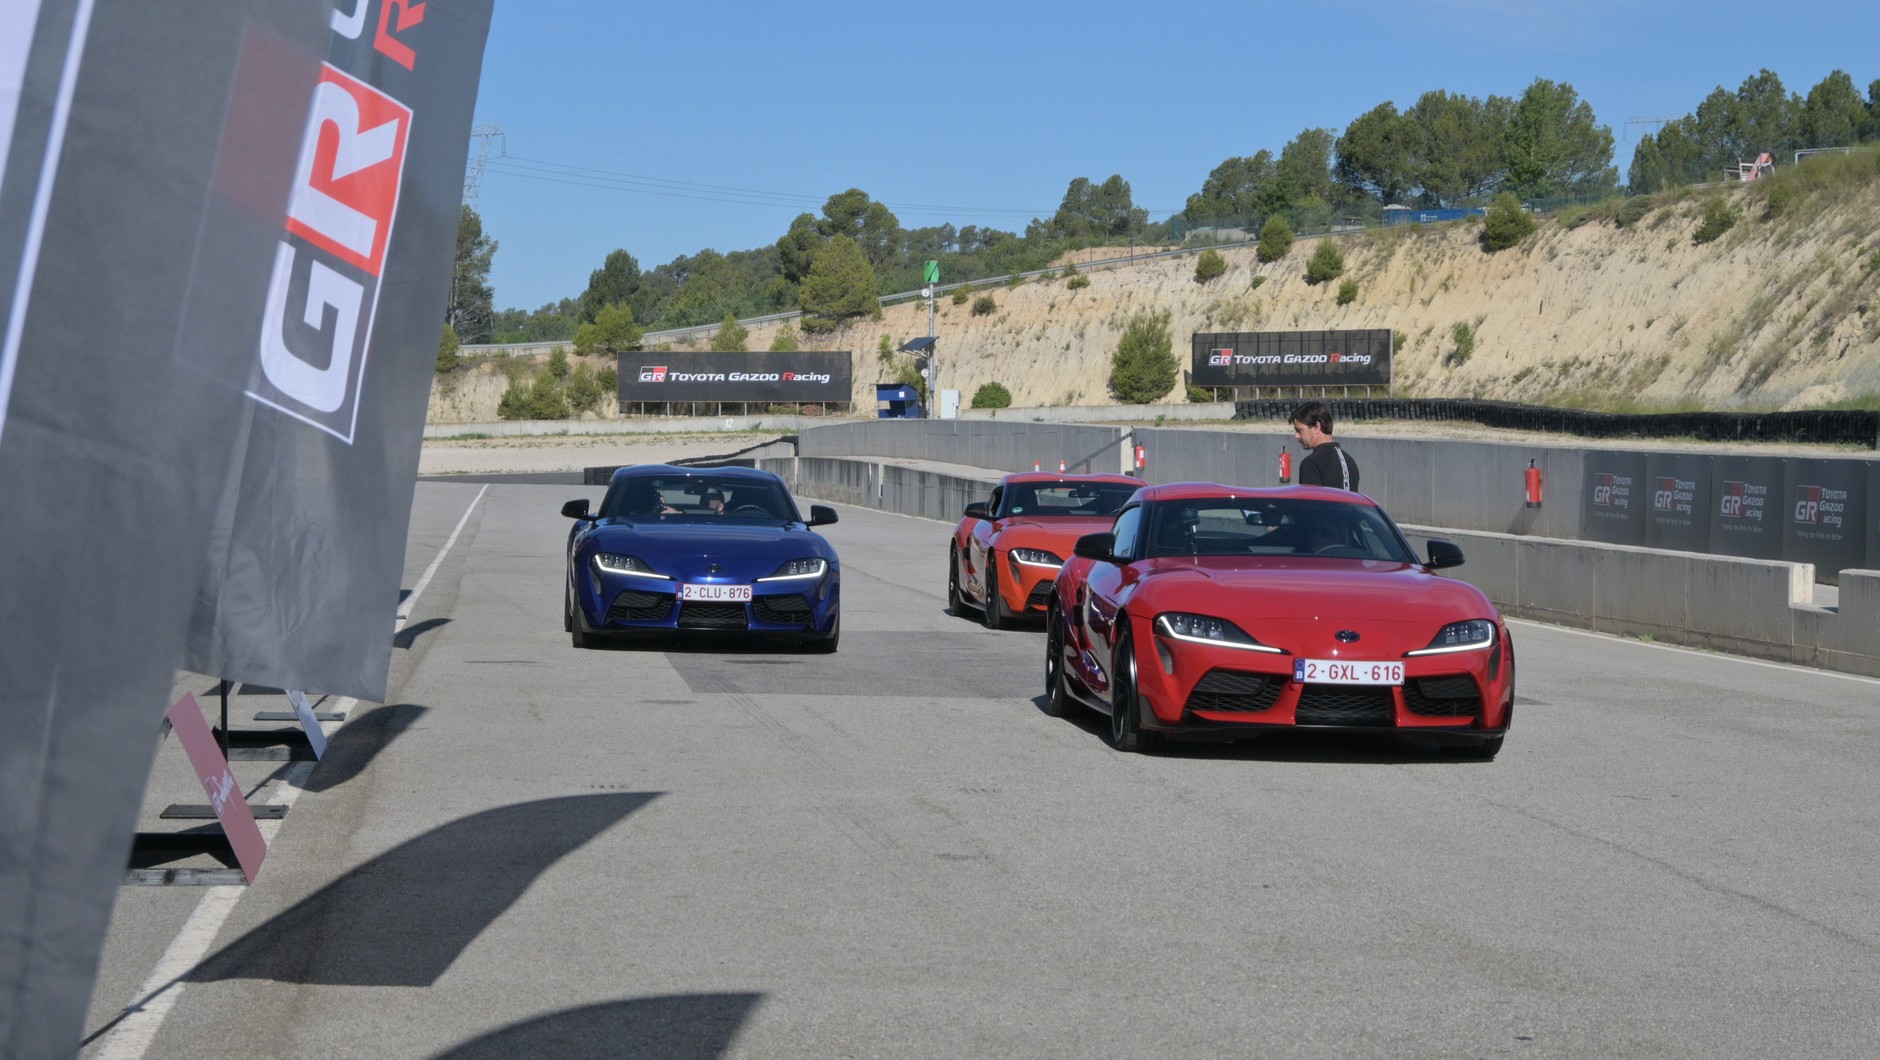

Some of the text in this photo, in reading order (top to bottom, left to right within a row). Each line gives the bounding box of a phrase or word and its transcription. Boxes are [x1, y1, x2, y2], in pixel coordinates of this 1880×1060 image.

[260, 80, 400, 413] GR
[1234, 355, 1281, 364] TOYOTA
[1283, 354, 1327, 363] GAZOO
[1329, 353, 1371, 365] Racing
[669, 372, 725, 381] TOYOTA
[728, 372, 779, 381] GAZOO
[782, 372, 830, 384] Racing
[725, 418, 734, 428] 12
[1613, 475, 1632, 486] TOYOTA
[1675, 479, 1696, 490] TOYOTA
[1611, 486, 1629, 496] GAZOO
[1744, 483, 1767, 495] TOYOTA
[1821, 488, 1847, 500] TOYOTA
[1673, 490, 1693, 501] GAZOO
[1742, 495, 1764, 507] GAZOO
[1819, 500, 1843, 512] GAZOO
[1296, 670, 1303, 679] B
